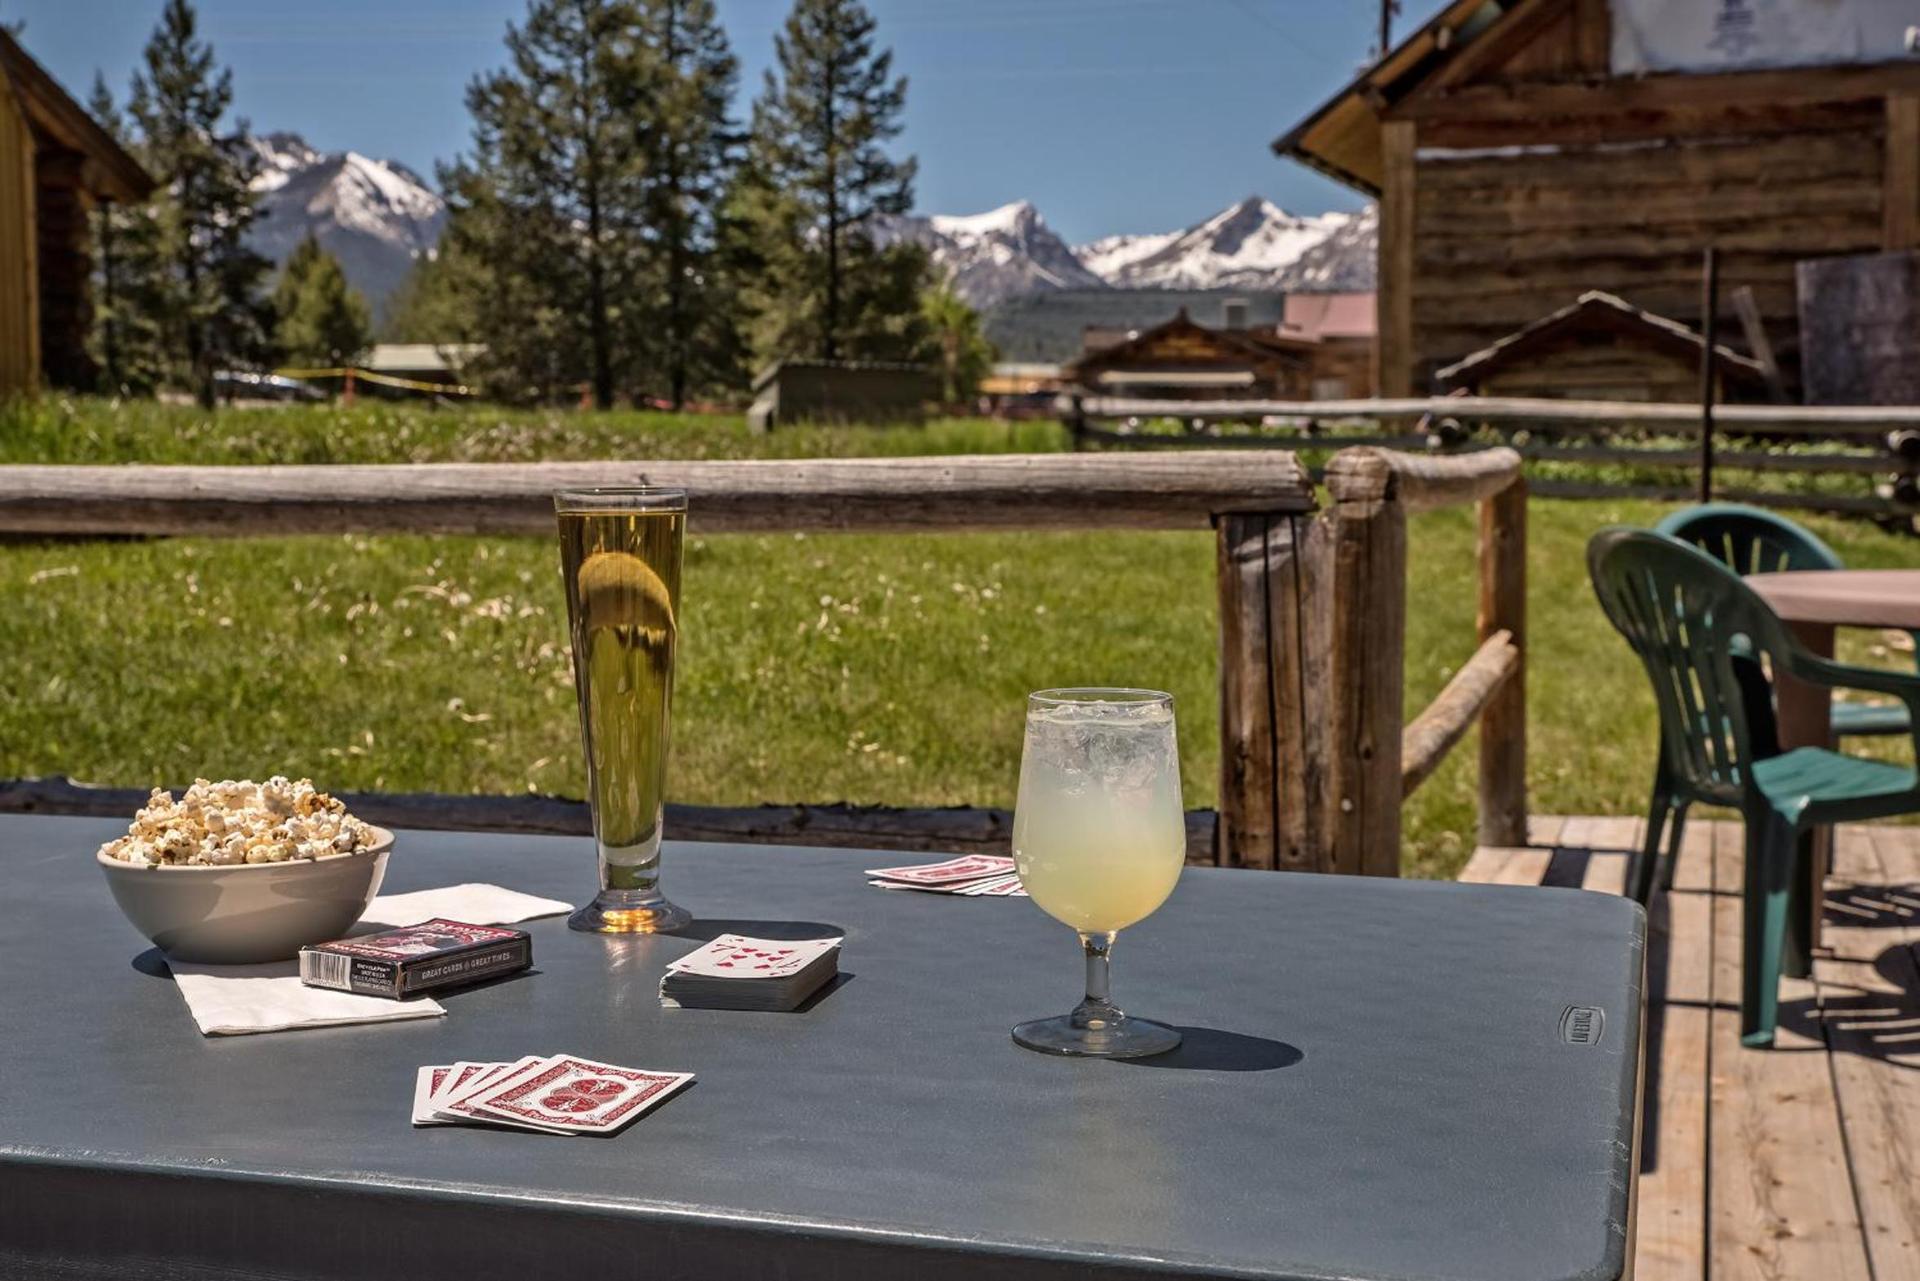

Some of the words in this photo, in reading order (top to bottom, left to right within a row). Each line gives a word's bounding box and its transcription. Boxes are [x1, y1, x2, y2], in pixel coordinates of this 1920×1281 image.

[421, 967, 441, 980] GREAT
[442, 962, 463, 975] CARDS
[470, 957, 491, 968] GREAT
